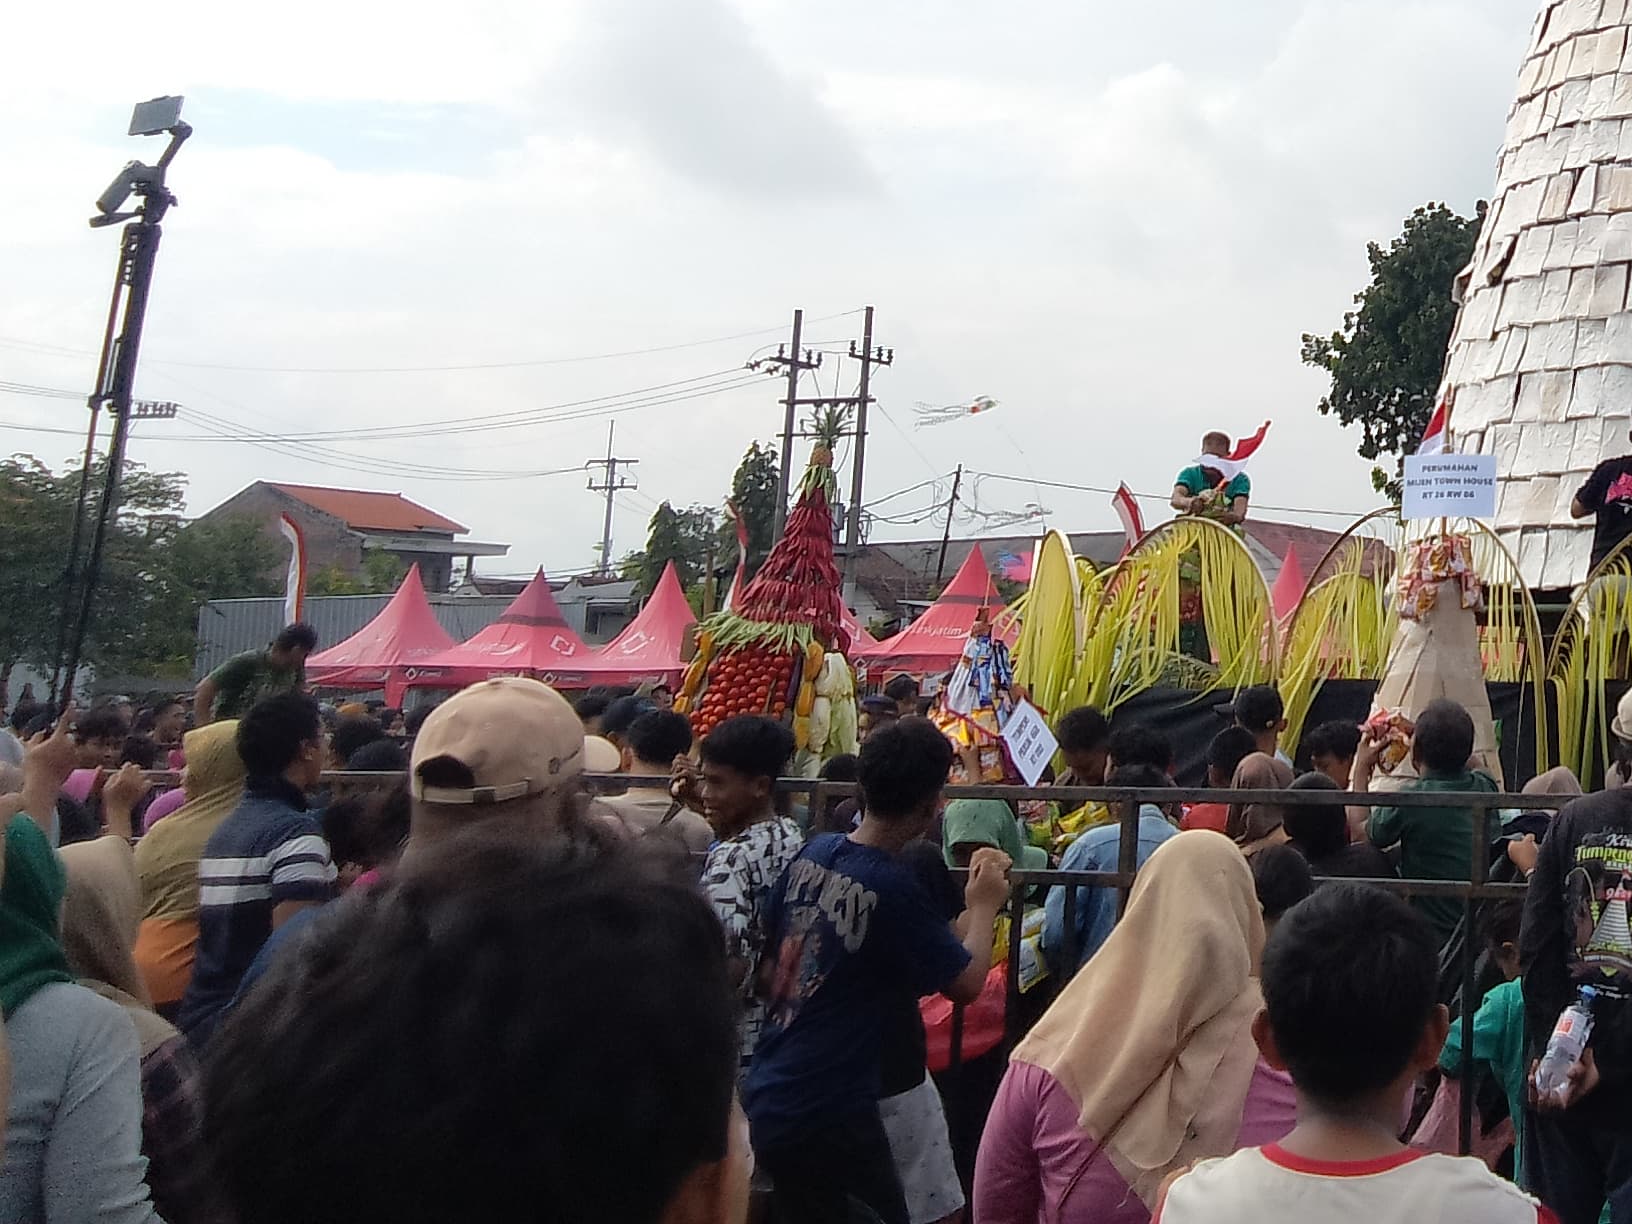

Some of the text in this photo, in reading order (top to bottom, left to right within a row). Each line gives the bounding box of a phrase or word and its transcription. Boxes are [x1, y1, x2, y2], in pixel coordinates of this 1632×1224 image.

[1421, 463, 1478, 473] PERUMAHAN
[1434, 476, 1461, 486] TOWN
[1463, 476, 1493, 486] HOUSE
[1422, 491, 1433, 499] RT
[1446, 490, 1462, 498] RW
